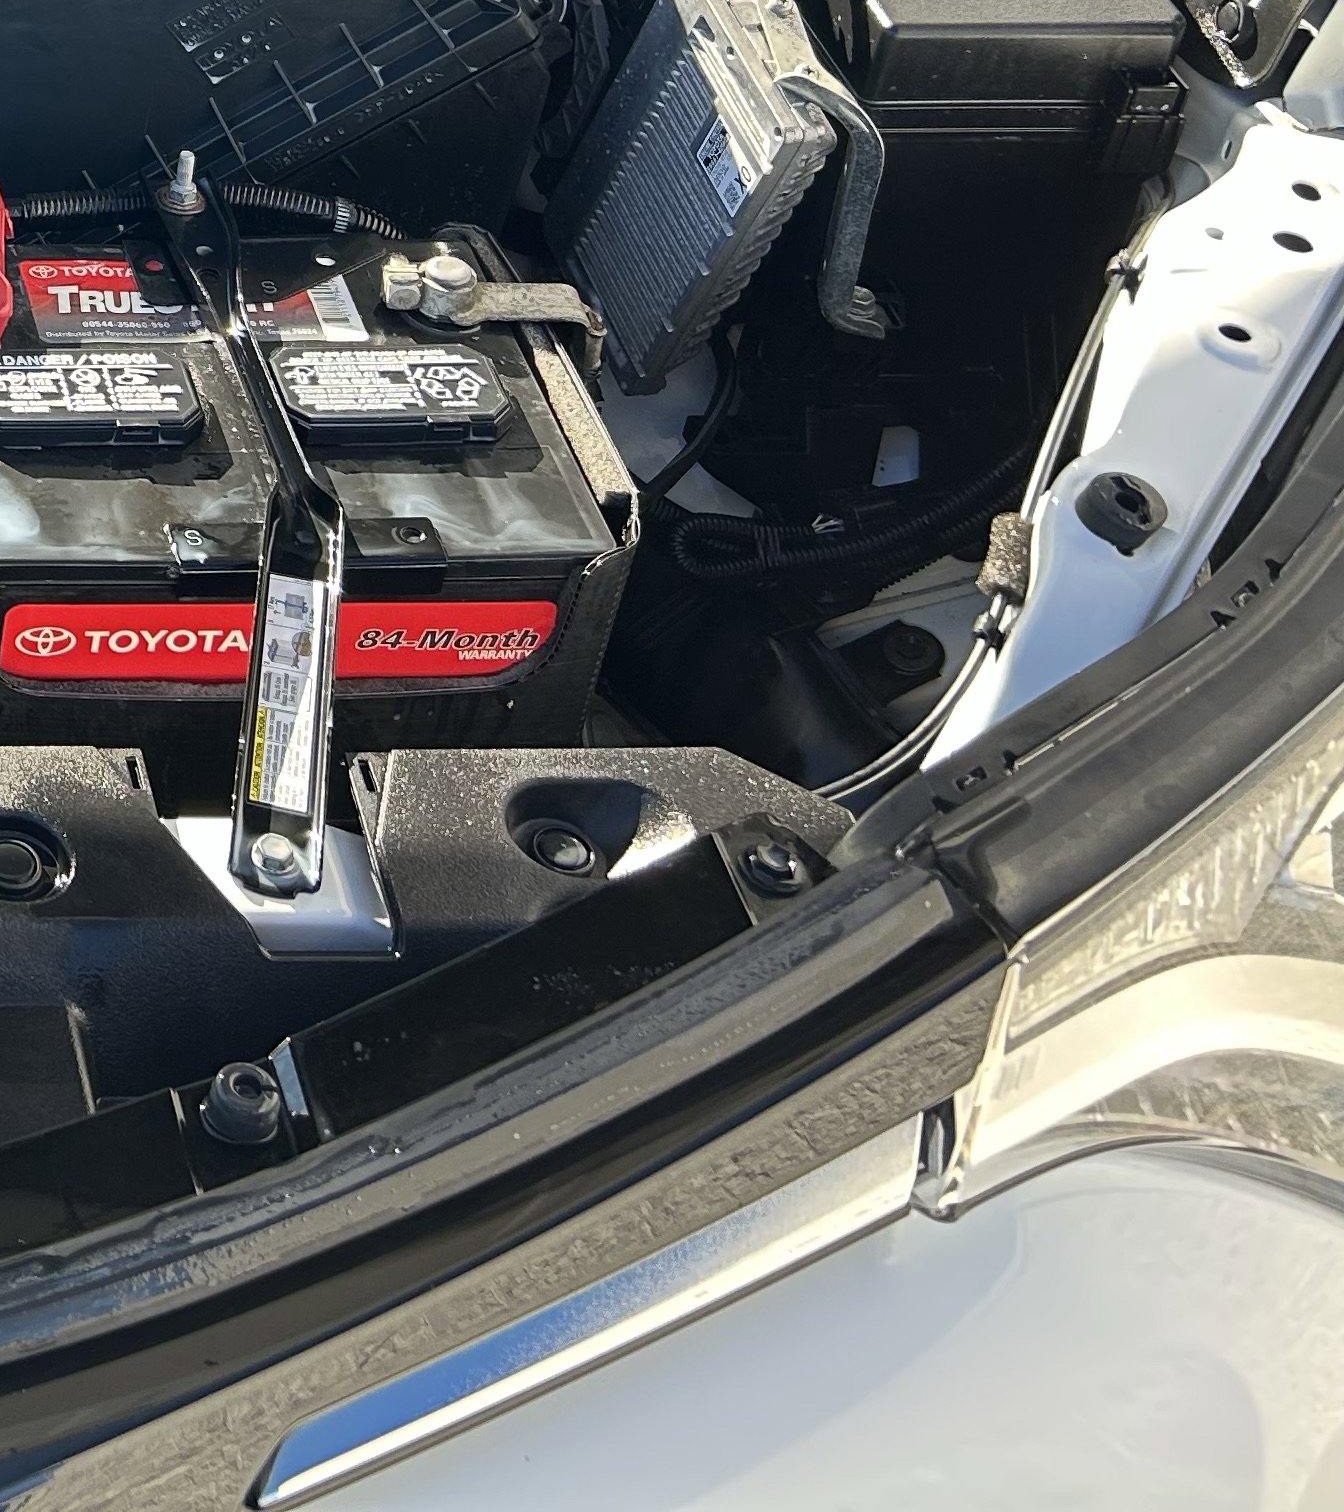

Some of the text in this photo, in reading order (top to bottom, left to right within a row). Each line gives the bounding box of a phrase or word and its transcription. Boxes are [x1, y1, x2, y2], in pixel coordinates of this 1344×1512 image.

[59, 265, 135, 278] TOYOTA
[261, 280, 278, 295] S
[2, 354, 74, 366] DANGER
[90, 352, 158, 365] POISON
[184, 529, 203, 547] S
[84, 628, 541, 653] TOYOTA 84-Month
[458, 649, 533, 661] WARRANTY
